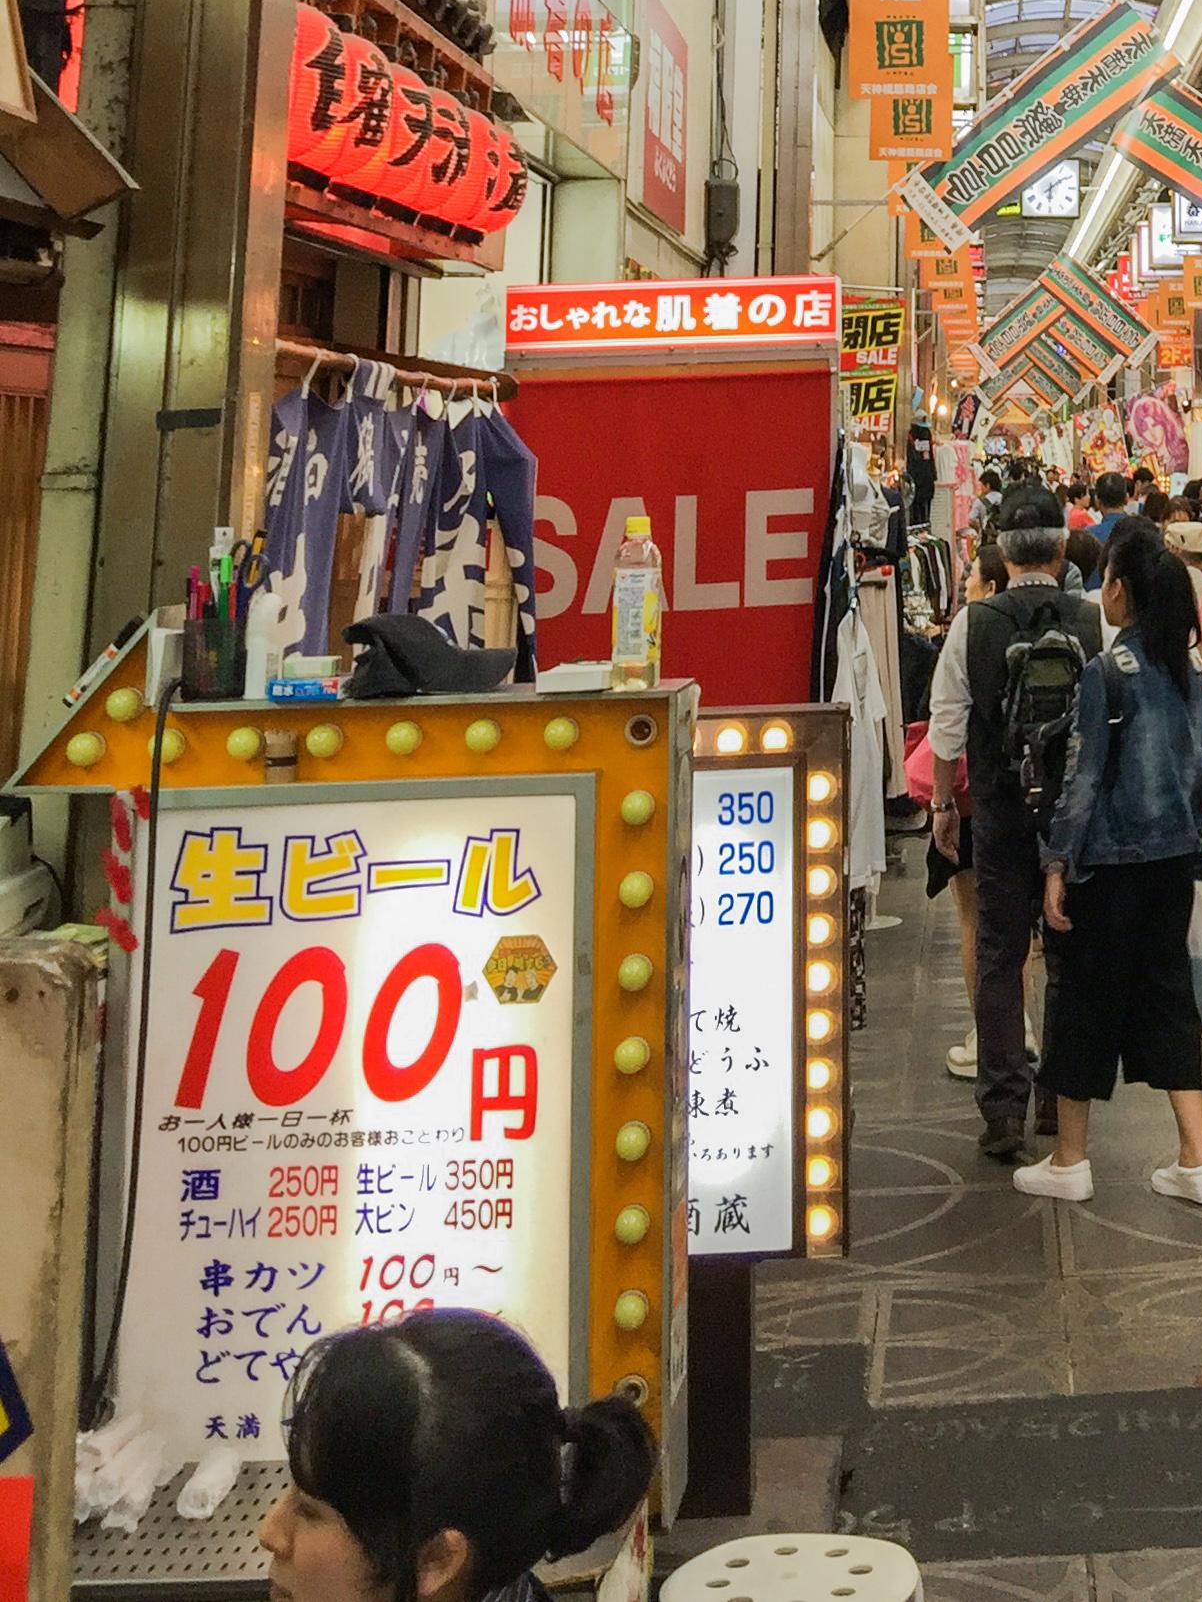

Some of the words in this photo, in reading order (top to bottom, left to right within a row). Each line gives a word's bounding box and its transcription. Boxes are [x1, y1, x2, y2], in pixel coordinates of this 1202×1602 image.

[509, 290, 832, 332] おしゃれな肌着の店
[856, 348, 897, 365] SALE
[532, 489, 814, 618] SALE
[718, 790, 774, 826] 350
[719, 840, 775, 876] 250
[170, 827, 542, 934] 生ビール
[718, 890, 774, 926] 270
[157, 1109, 354, 1132] お一人様一日一杯
[178, 1126, 465, 1154] 100円ビールのみのお客様おことわり
[180, 1168, 221, 1202] 酒
[268, 1165, 339, 1199] 250円
[356, 1162, 437, 1196] 生ビール
[445, 1158, 514, 1191] 350円
[179, 1206, 261, 1241] チューハイ
[267, 1205, 337, 1238] 250円
[355, 1203, 415, 1236] 大ビン
[444, 1198, 513, 1231] 450円
[200, 1259, 327, 1297] 串カツ
[196, 1303, 322, 1339] おでん
